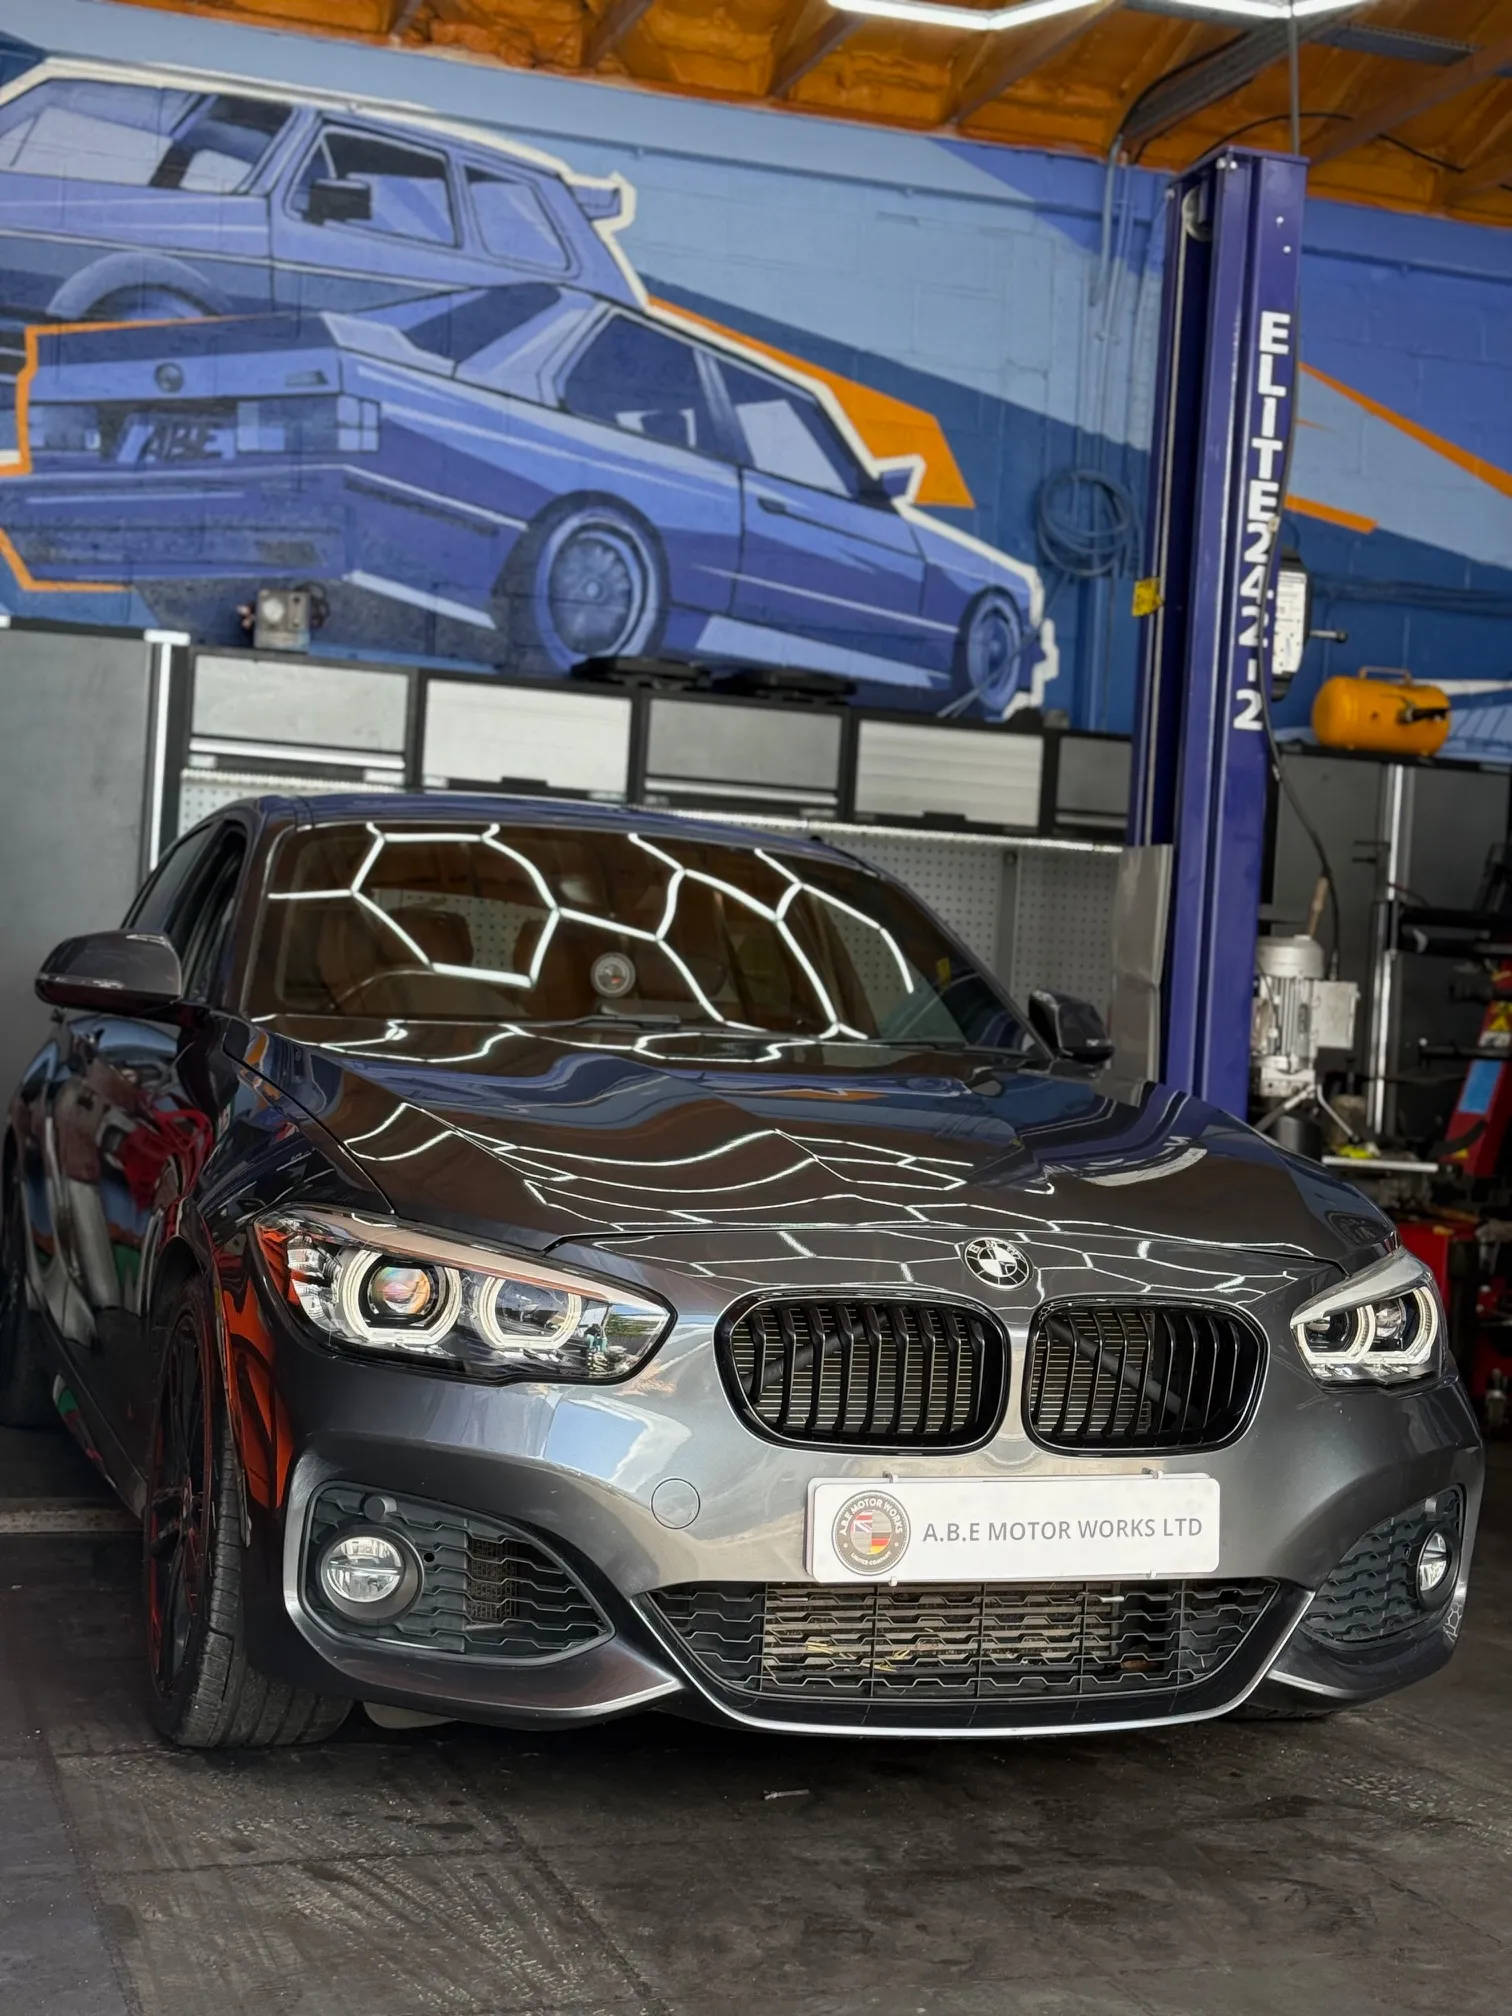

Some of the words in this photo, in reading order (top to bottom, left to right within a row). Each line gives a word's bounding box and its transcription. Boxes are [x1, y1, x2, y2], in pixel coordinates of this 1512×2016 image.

[850, 1498, 883, 1514] MOTOR
[883, 1501, 903, 1534] WORKS
[922, 1523, 980, 1542] A.B.E
[988, 1521, 1071, 1541] MOTOR
[1077, 1518, 1156, 1538] WORKS
[1163, 1517, 1202, 1537] LTD
[850, 1552, 869, 1566] LIMITED
[869, 1550, 891, 1566] COMPANY
